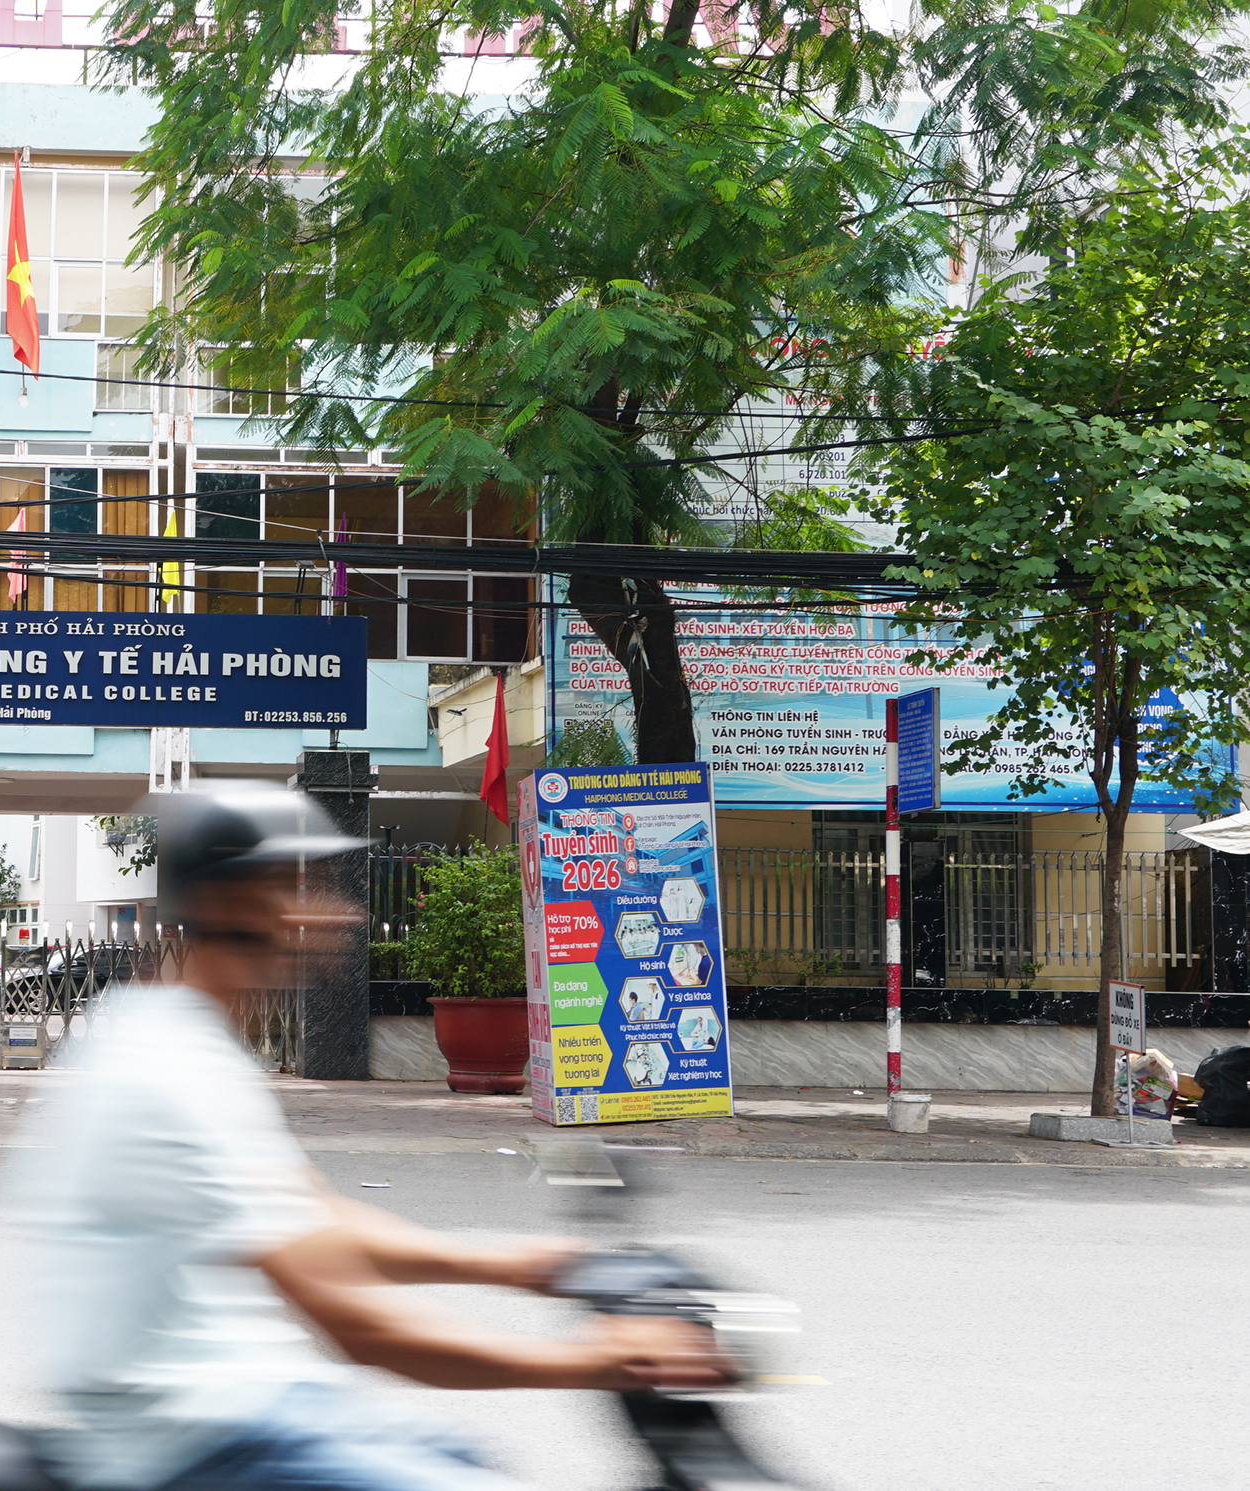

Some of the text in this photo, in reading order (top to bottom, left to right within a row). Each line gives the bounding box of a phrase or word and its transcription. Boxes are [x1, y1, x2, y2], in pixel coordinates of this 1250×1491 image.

[15, 616, 60, 635] PHỐ
[66, 617, 104, 636] HẢI
[113, 618, 186, 637] PHÒNG
[708, 619, 854, 638] SINH: XÉT TUYỂN HỌC BẠ
[570, 640, 601, 656] HÌNH
[680, 642, 697, 657] KÝ:
[700, 644, 735, 658] ĐĂNG
[738, 644, 752, 658] KÝ
[756, 646, 788, 661] TRỰC
[792, 643, 830, 658] TUYẾN
[834, 644, 863, 658] TRÊN
[867, 643, 900, 659] CỔNG
[63, 650, 84, 675] Y
[99, 643, 143, 675] TẾ
[152, 643, 210, 676] HẢI
[222, 648, 342, 678] PHÒNG
[571, 660, 588, 675] BỘ
[591, 658, 622, 673] GIÁO
[703, 663, 729, 677] TẠO;
[732, 661, 766, 675] ĐĂNG
[770, 661, 785, 675] KÝ
[788, 664, 820, 678] TRỰC
[824, 661, 862, 675] TUYẾN
[866, 662, 895, 676] TRÊN
[978, 667, 1007, 677] SINH
[571, 674, 899, 695] CỦA NỘP HỒ SƠ TRỰC TIẾP TẠI TRƯỜNG
[104, 685, 217, 702] COLLEGE
[17, 706, 51, 720] Phòng
[245, 710, 348, 723] ĐT:02253.856.256
[711, 709, 819, 725] THÔNG TIN LIÊN HỆ
[712, 725, 737, 738] VĂN
[740, 726, 783, 739] PHÒNG
[787, 724, 821, 739] TUYỂN
[825, 729, 852, 739] SINH
[944, 725, 978, 740] ĐẲNG
[712, 745, 733, 758] ĐỊA
[736, 742, 760, 755] CHỈ:
[765, 745, 785, 755] 169
[789, 741, 818, 756] TRẦN
[822, 744, 869, 756] NGUYÊN
[1015, 747, 1029, 757] TP.
[713, 759, 738, 773] ĐIỆN
[742, 762, 781, 774] THOẠI:
[785, 762, 864, 772] 0225.3781412
[995, 764, 1022, 773] 0985
[1050, 765, 1073, 774] 465.
[568, 769, 702, 790] TRƯỜNG CAO ĐẲNG Y TẾ HẢI PHÒNG
[584, 789, 688, 804] HAIPHONG MEDICAL COLLEGE
[561, 812, 616, 827] THÔNG TIN
[543, 830, 586, 858] Tuyển
[588, 831, 618, 855] sinh
[562, 860, 620, 891] 2026
[573, 916, 599, 930] 70%
[663, 927, 683, 936] Dược
[640, 961, 666, 971] Hộ sinh
[553, 981, 588, 992] Đa dạng
[554, 998, 581, 1009] ngành
[693, 992, 711, 1001] khoa
[1116, 988, 1134, 1010] KHÔNG
[1111, 1011, 1140, 1030] DỪNG XE
[558, 1037, 581, 1048] Nhiều
[1123, 1032, 1132, 1046] ĐÂY
[559, 1054, 603, 1064] vọng trong
[591, 1068, 600, 1077] lai
